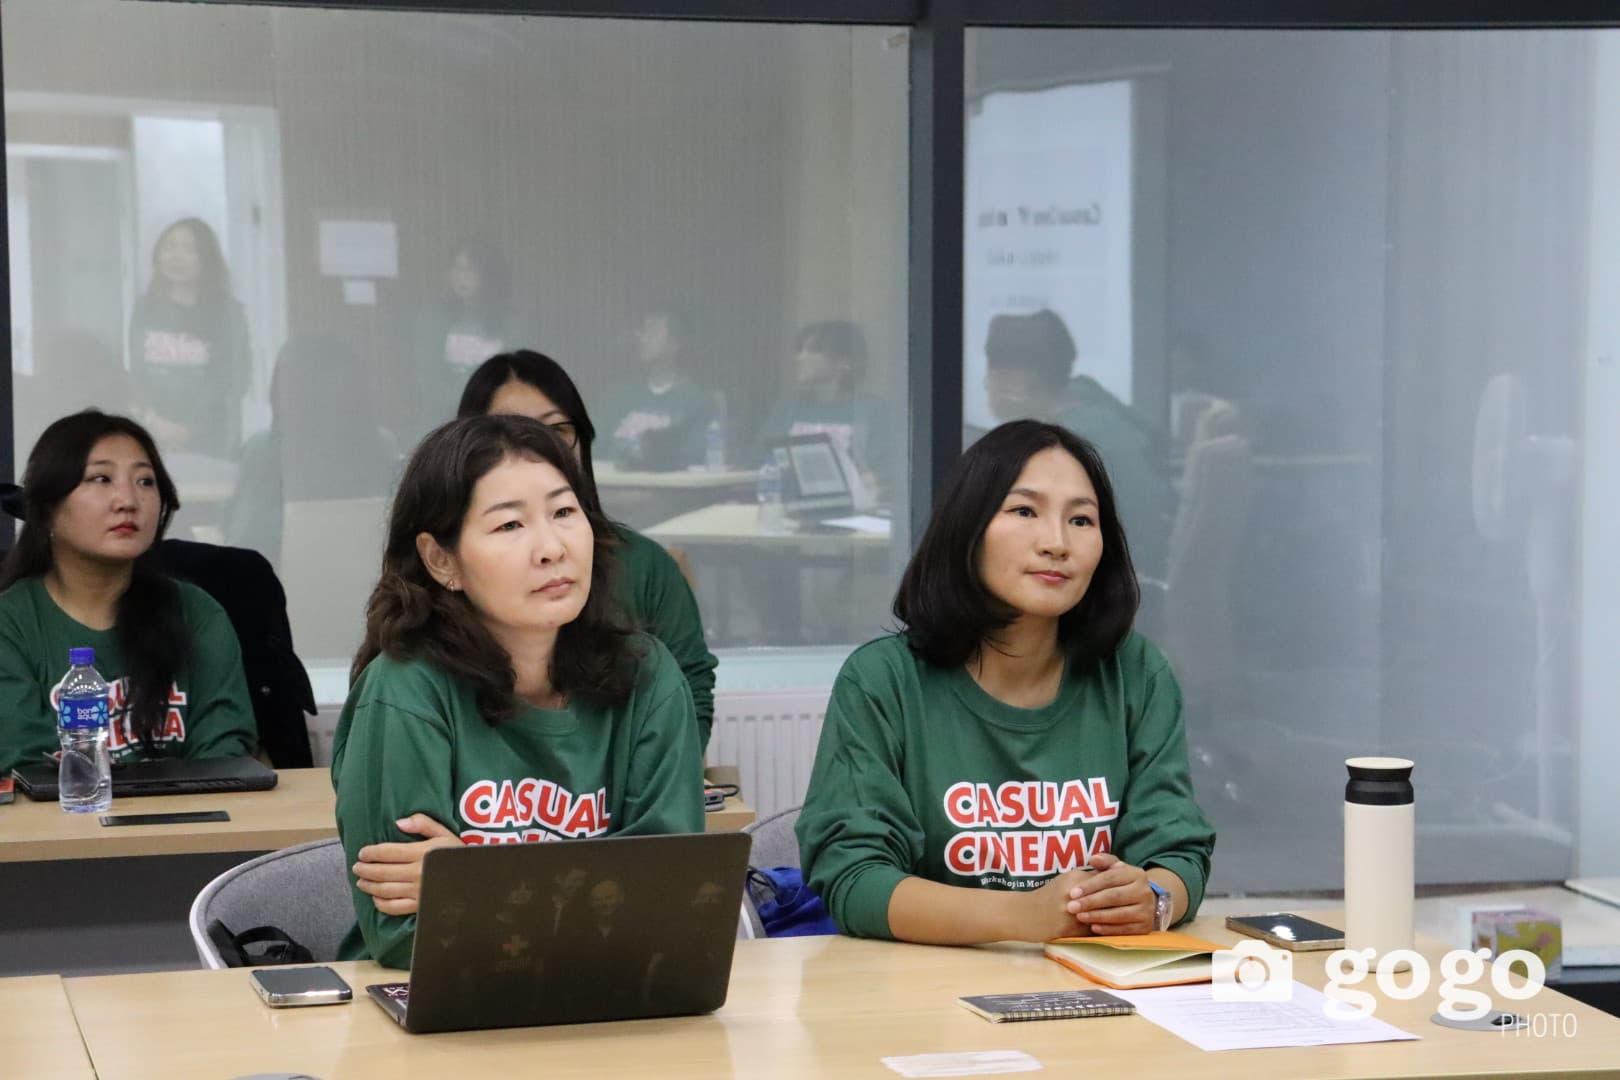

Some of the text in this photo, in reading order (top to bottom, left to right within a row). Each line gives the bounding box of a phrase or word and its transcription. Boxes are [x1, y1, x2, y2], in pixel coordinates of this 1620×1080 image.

[459, 777, 611, 838] CASUAL
[944, 777, 1119, 828] CASUAL
[944, 825, 1112, 876] CINEMA
